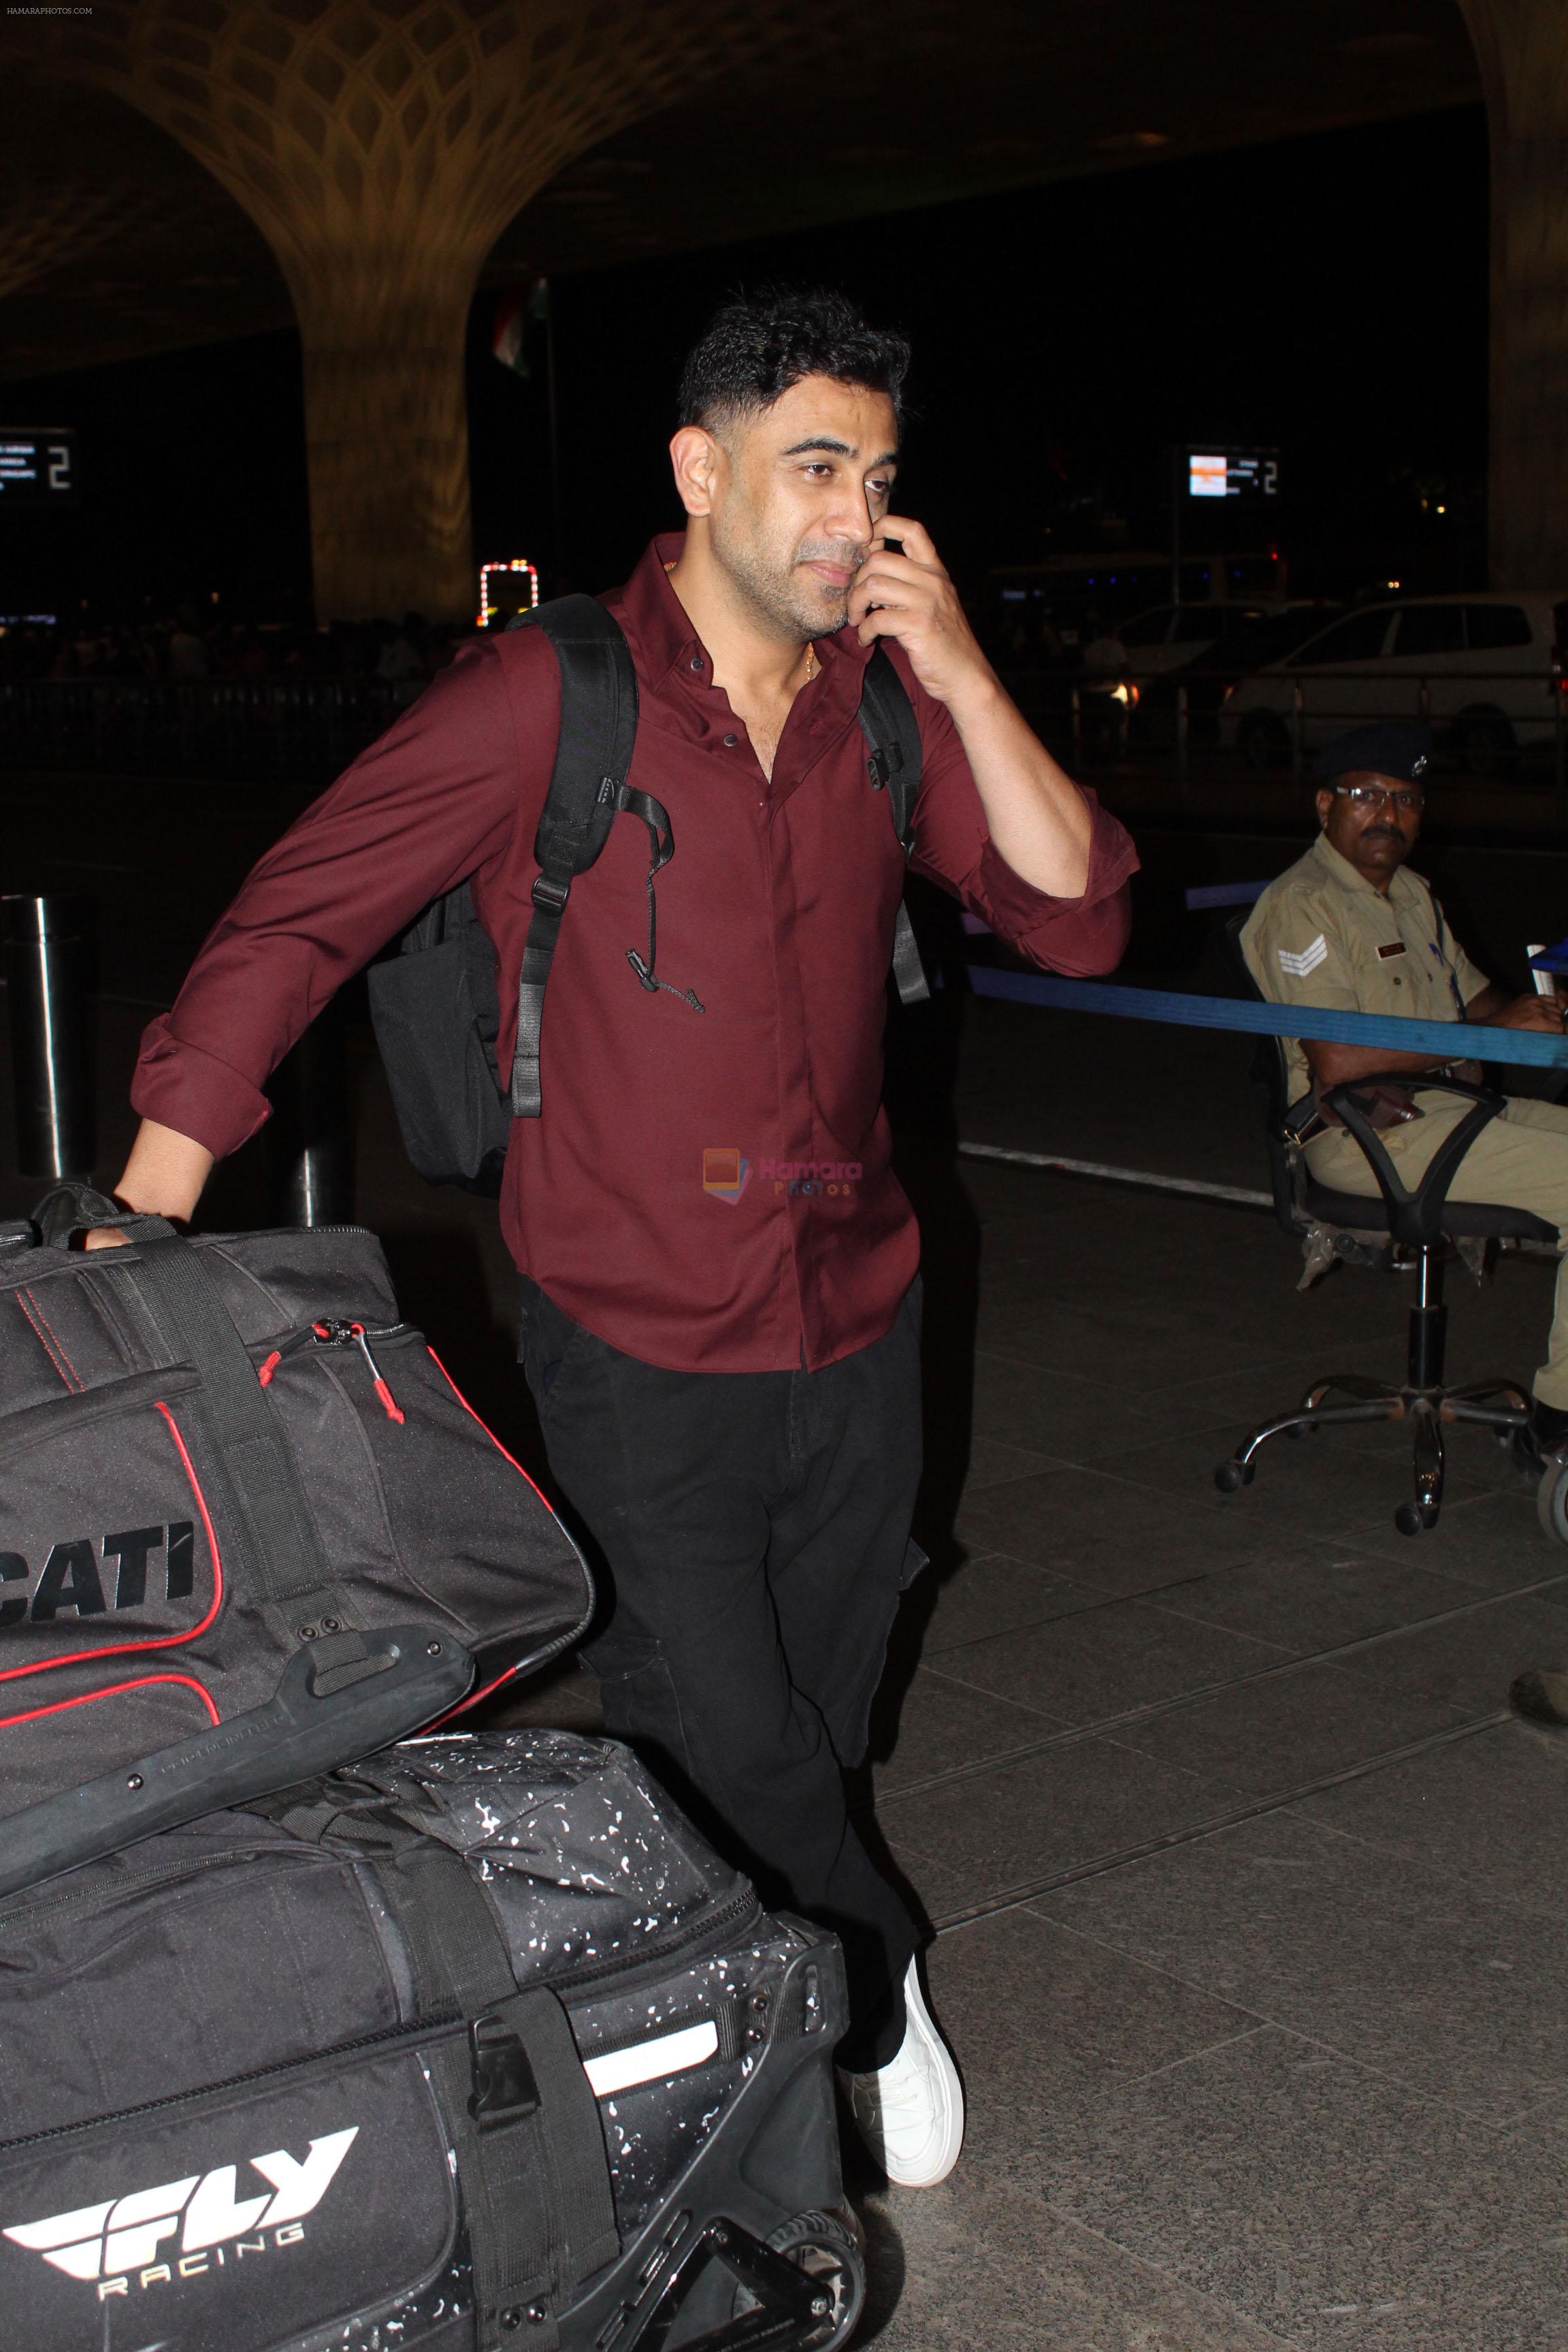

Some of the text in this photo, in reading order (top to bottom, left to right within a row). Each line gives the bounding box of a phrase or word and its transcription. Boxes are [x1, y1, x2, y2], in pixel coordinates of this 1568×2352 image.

[48, 446, 69, 489] 2
[1264, 460, 1277, 495] 2
[2, 2126, 359, 2280] FLY
[98, 2221, 305, 2302] RACING
